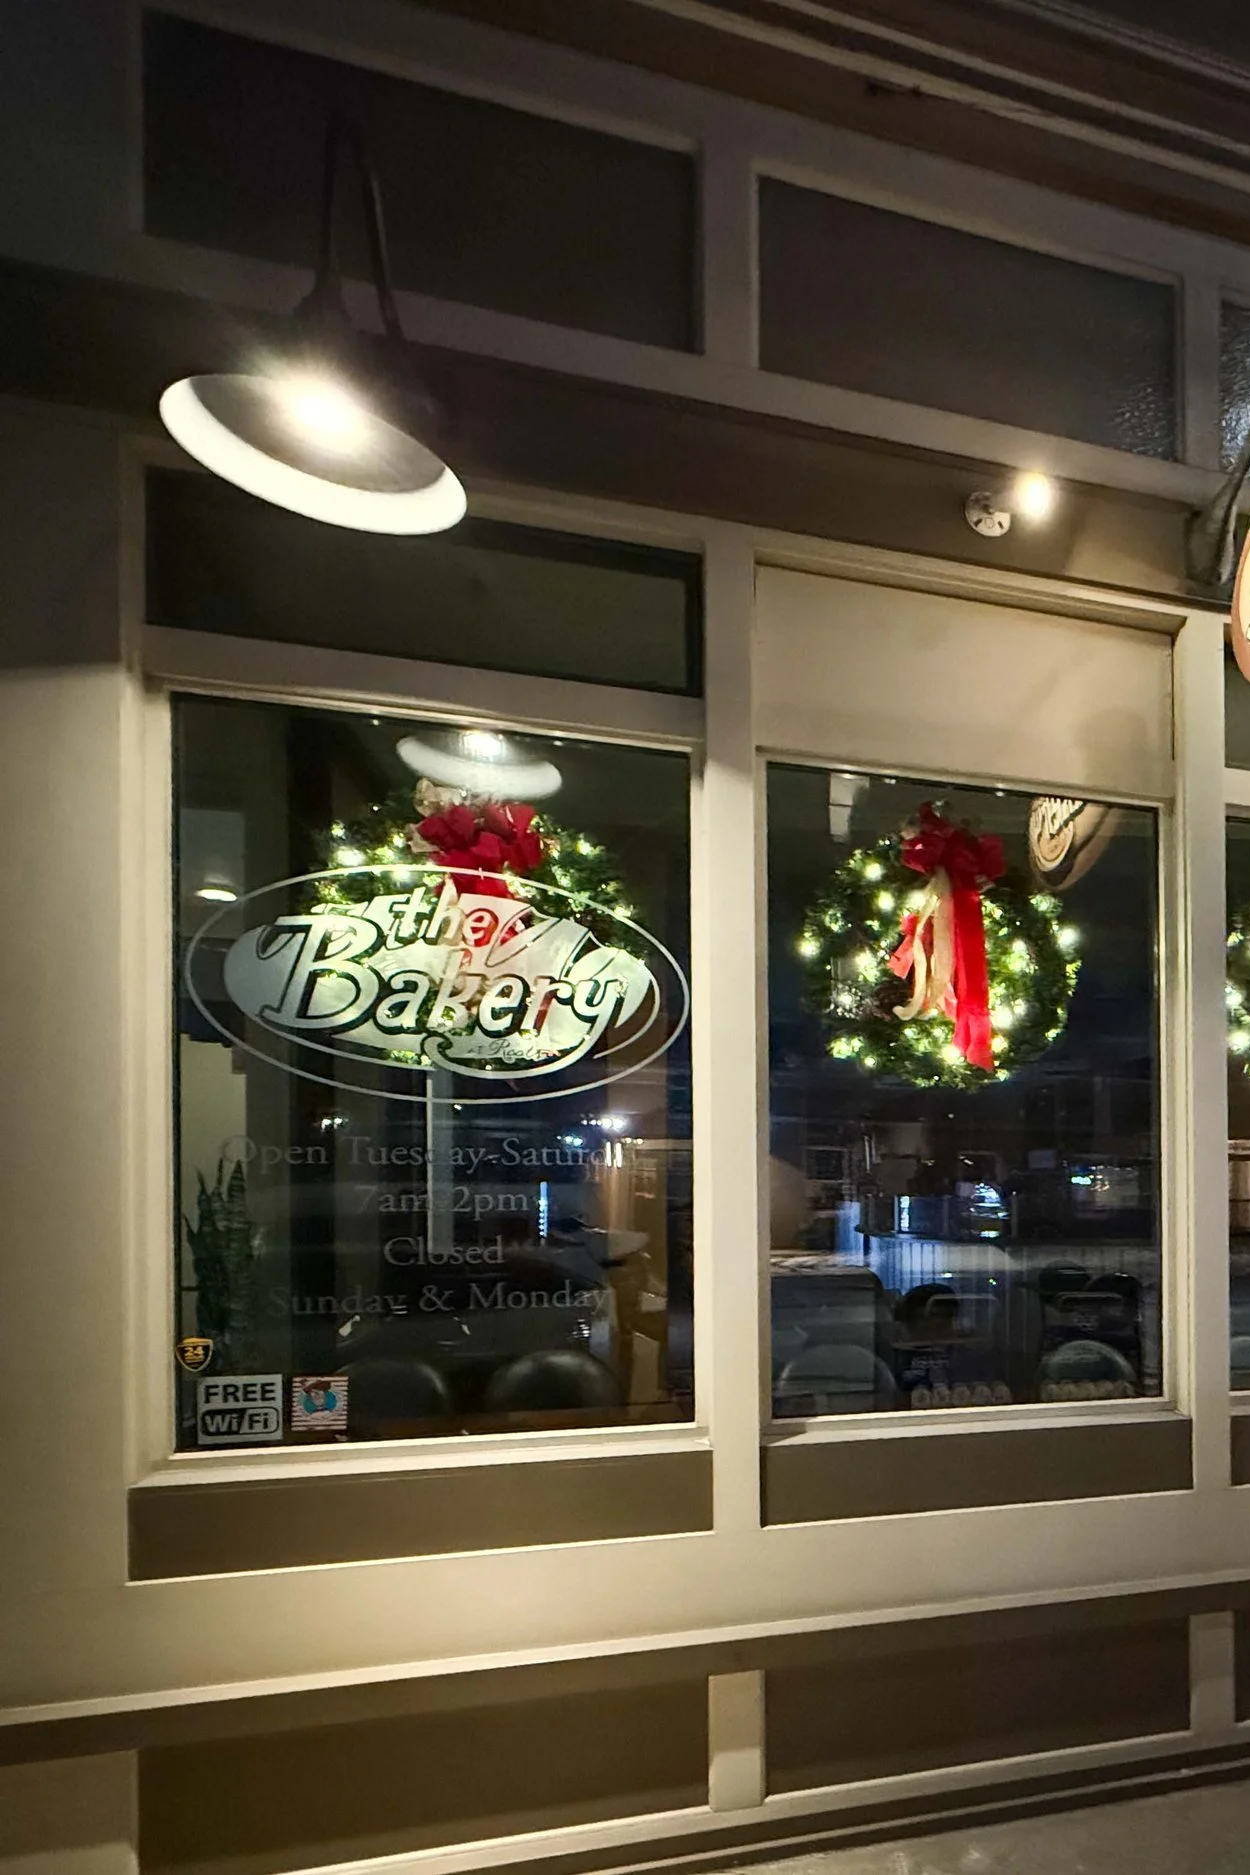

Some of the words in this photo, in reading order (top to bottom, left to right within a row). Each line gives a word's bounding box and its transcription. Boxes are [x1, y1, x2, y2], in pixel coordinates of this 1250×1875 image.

[398, 884, 500, 949] the
[256, 912, 624, 1078] Bakery
[223, 1136, 329, 1175] Open
[384, 1235, 505, 1266] Closed
[268, 1285, 408, 1321] Sunday
[419, 1284, 455, 1313] &
[467, 1279, 609, 1315] Monday
[203, 1382, 276, 1404] FREE
